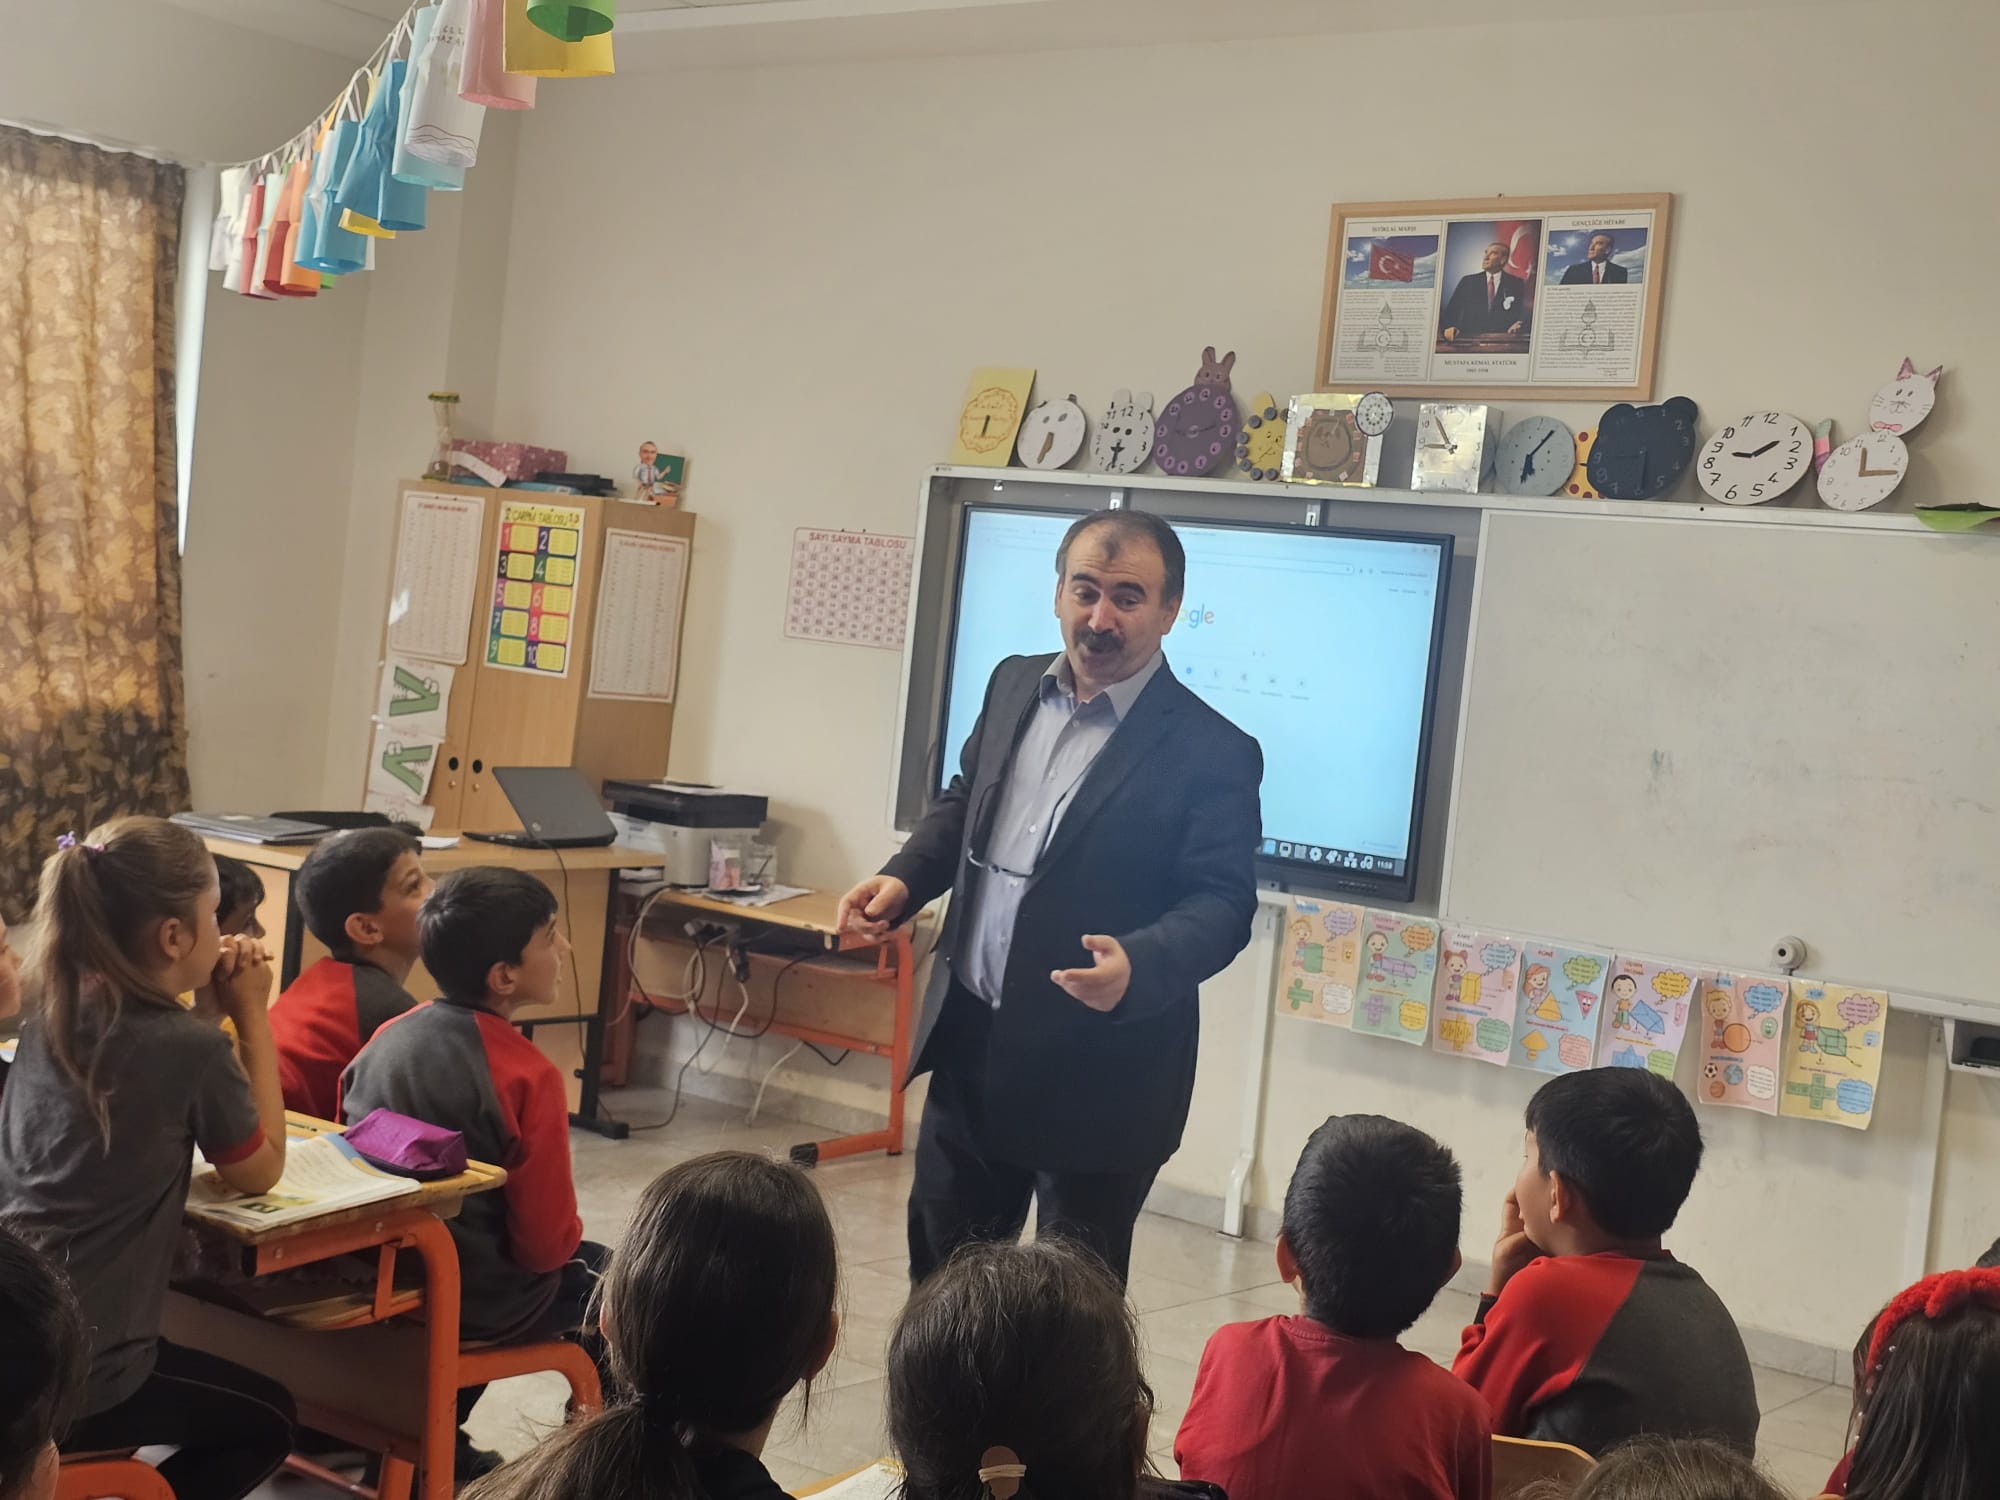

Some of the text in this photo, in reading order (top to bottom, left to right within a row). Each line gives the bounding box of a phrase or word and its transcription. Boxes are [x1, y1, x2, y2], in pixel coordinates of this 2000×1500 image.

[1120, 405, 1134, 417] 12
[1740, 415, 1754, 428] 11
[1763, 412, 1779, 425] 12
[1721, 426, 1735, 439] 10
[1790, 426, 1798, 437] 1
[1711, 441, 1724, 453] 9
[1789, 440, 1802, 454] 2
[1703, 457, 1716, 469] 8
[1783, 457, 1798, 470] 3
[1709, 472, 1721, 486] 7
[1767, 471, 1779, 483] 4
[1724, 484, 1738, 500] 6
[1749, 483, 1765, 497] 5
[504, 528, 510, 541] 1
[539, 531, 548, 550] 2
[809, 532, 907, 549] SAYI SAYMA TABLOSU
[500, 556, 507, 573] 3
[535, 560, 544, 578] 4
[533, 589, 541, 606] 6
[493, 611, 500, 629] 7
[1177, 603, 1215, 628] ogle
[530, 617, 538, 635] 8
[490, 640, 497, 658] 9
[527, 646, 537, 664] 10
